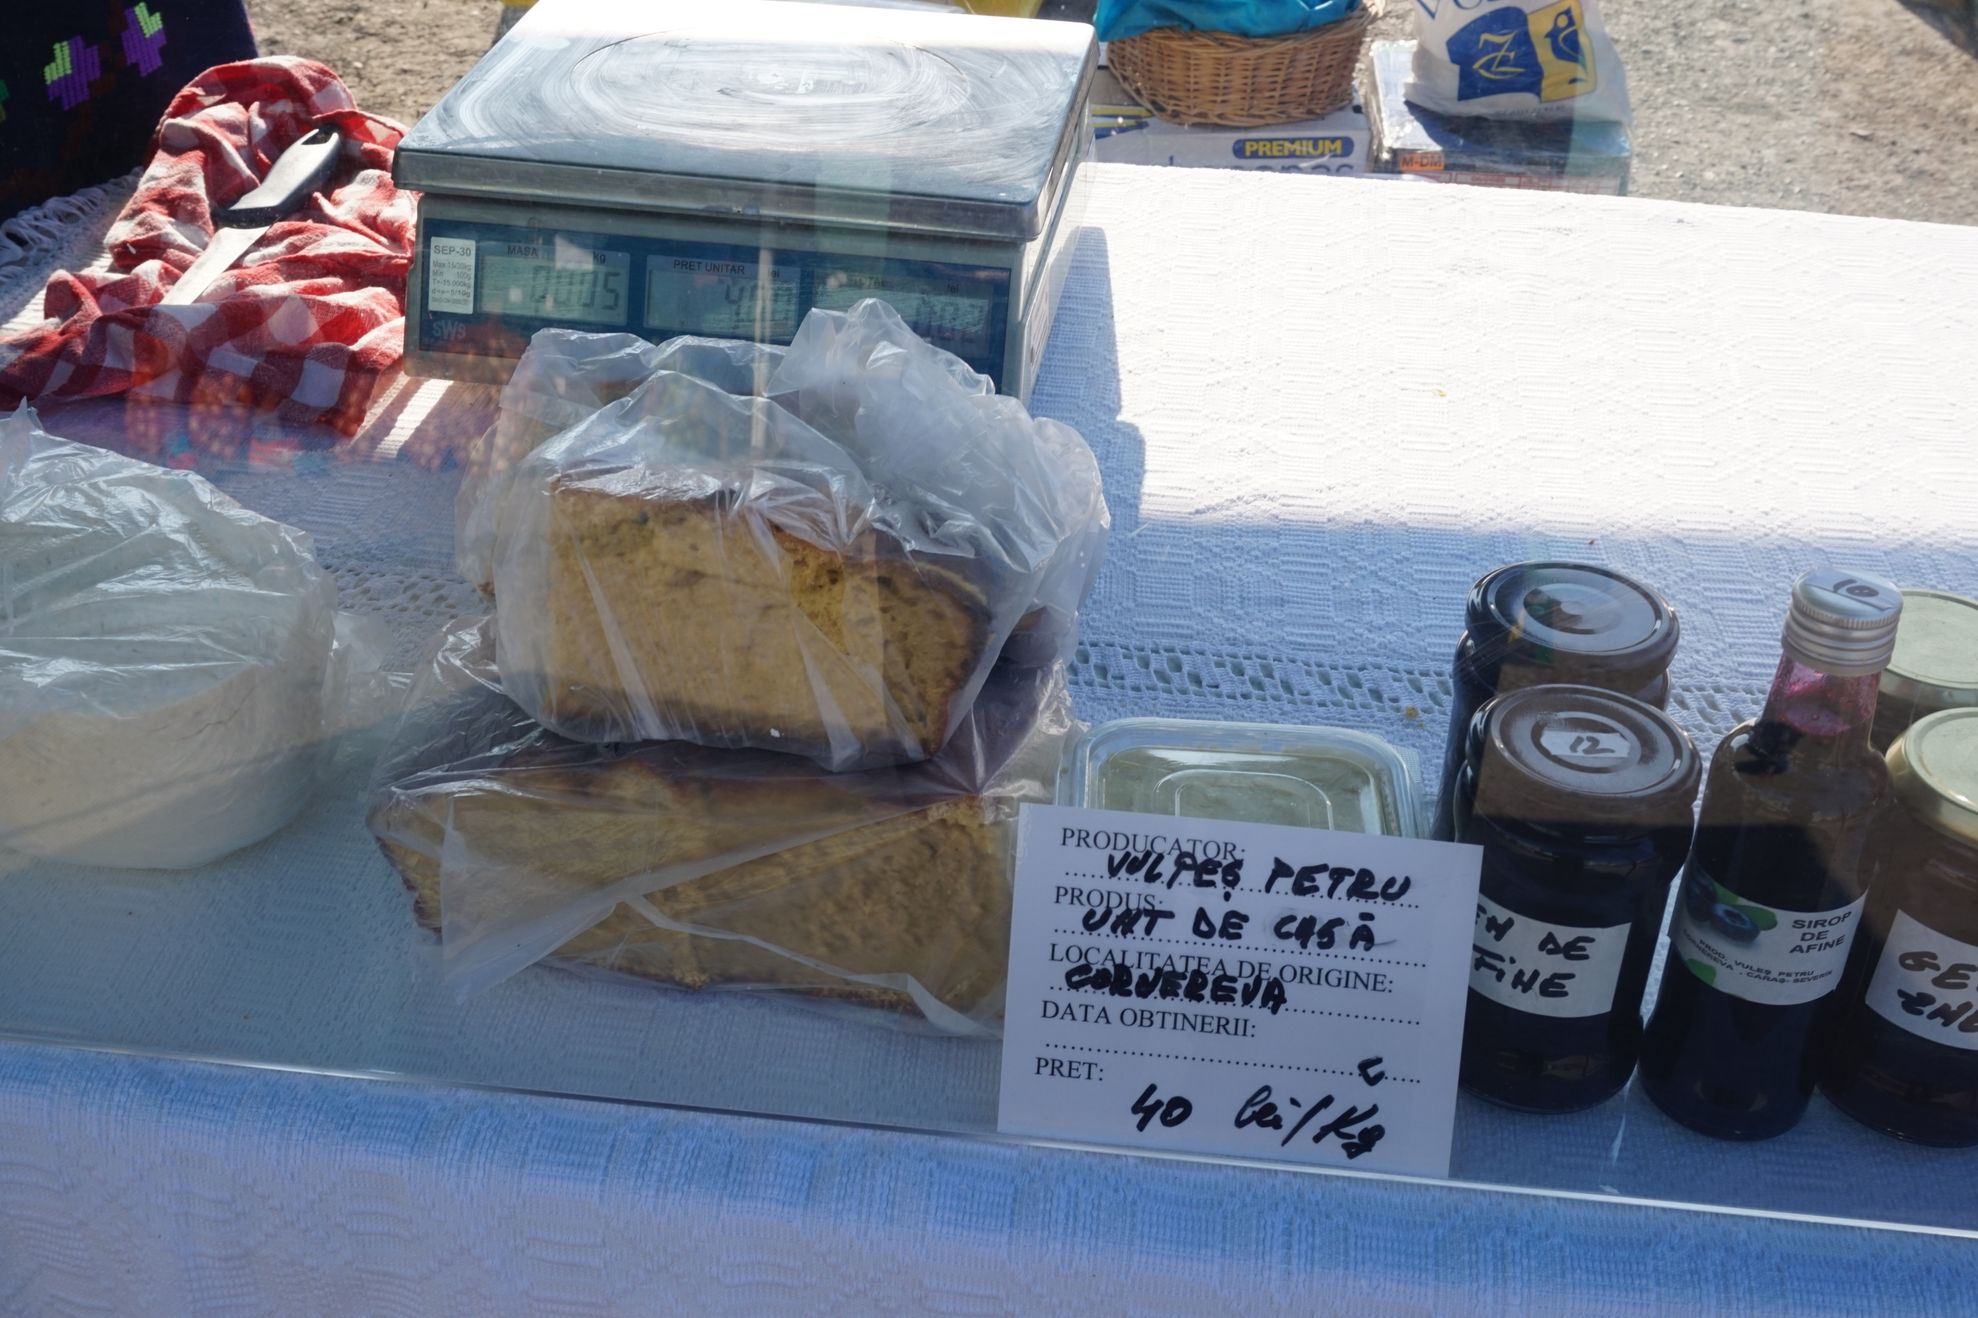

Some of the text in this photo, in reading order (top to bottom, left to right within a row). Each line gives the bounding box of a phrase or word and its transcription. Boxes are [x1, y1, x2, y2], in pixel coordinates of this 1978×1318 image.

[1244, 138, 1343, 157] PREMIUM
[433, 244, 472, 258] SEP-30
[507, 245, 538, 257] MASA
[673, 259, 702, 272] PRET
[705, 261, 745, 275] UNITAR
[1569, 735, 1617, 755] 12
[1060, 827, 1246, 863] PRODUCATOR:
[1264, 856, 1412, 901] PETRU
[1192, 906, 1250, 940] DE
[1791, 910, 1853, 929] SIROP
[1537, 931, 1597, 961] DE
[1788, 934, 1847, 954] AFINE
[1800, 930, 1830, 942] DE
[1048, 943, 1394, 994] LOCALITATEA DE ORIGINE:
[1777, 969, 1815, 978] PETRU
[1897, 950, 1978, 993] GE
[1041, 1000, 1257, 1038] DATA OBTINERII:
[1034, 1056, 1104, 1082] PRET:
[1131, 1083, 1193, 1132] 40
